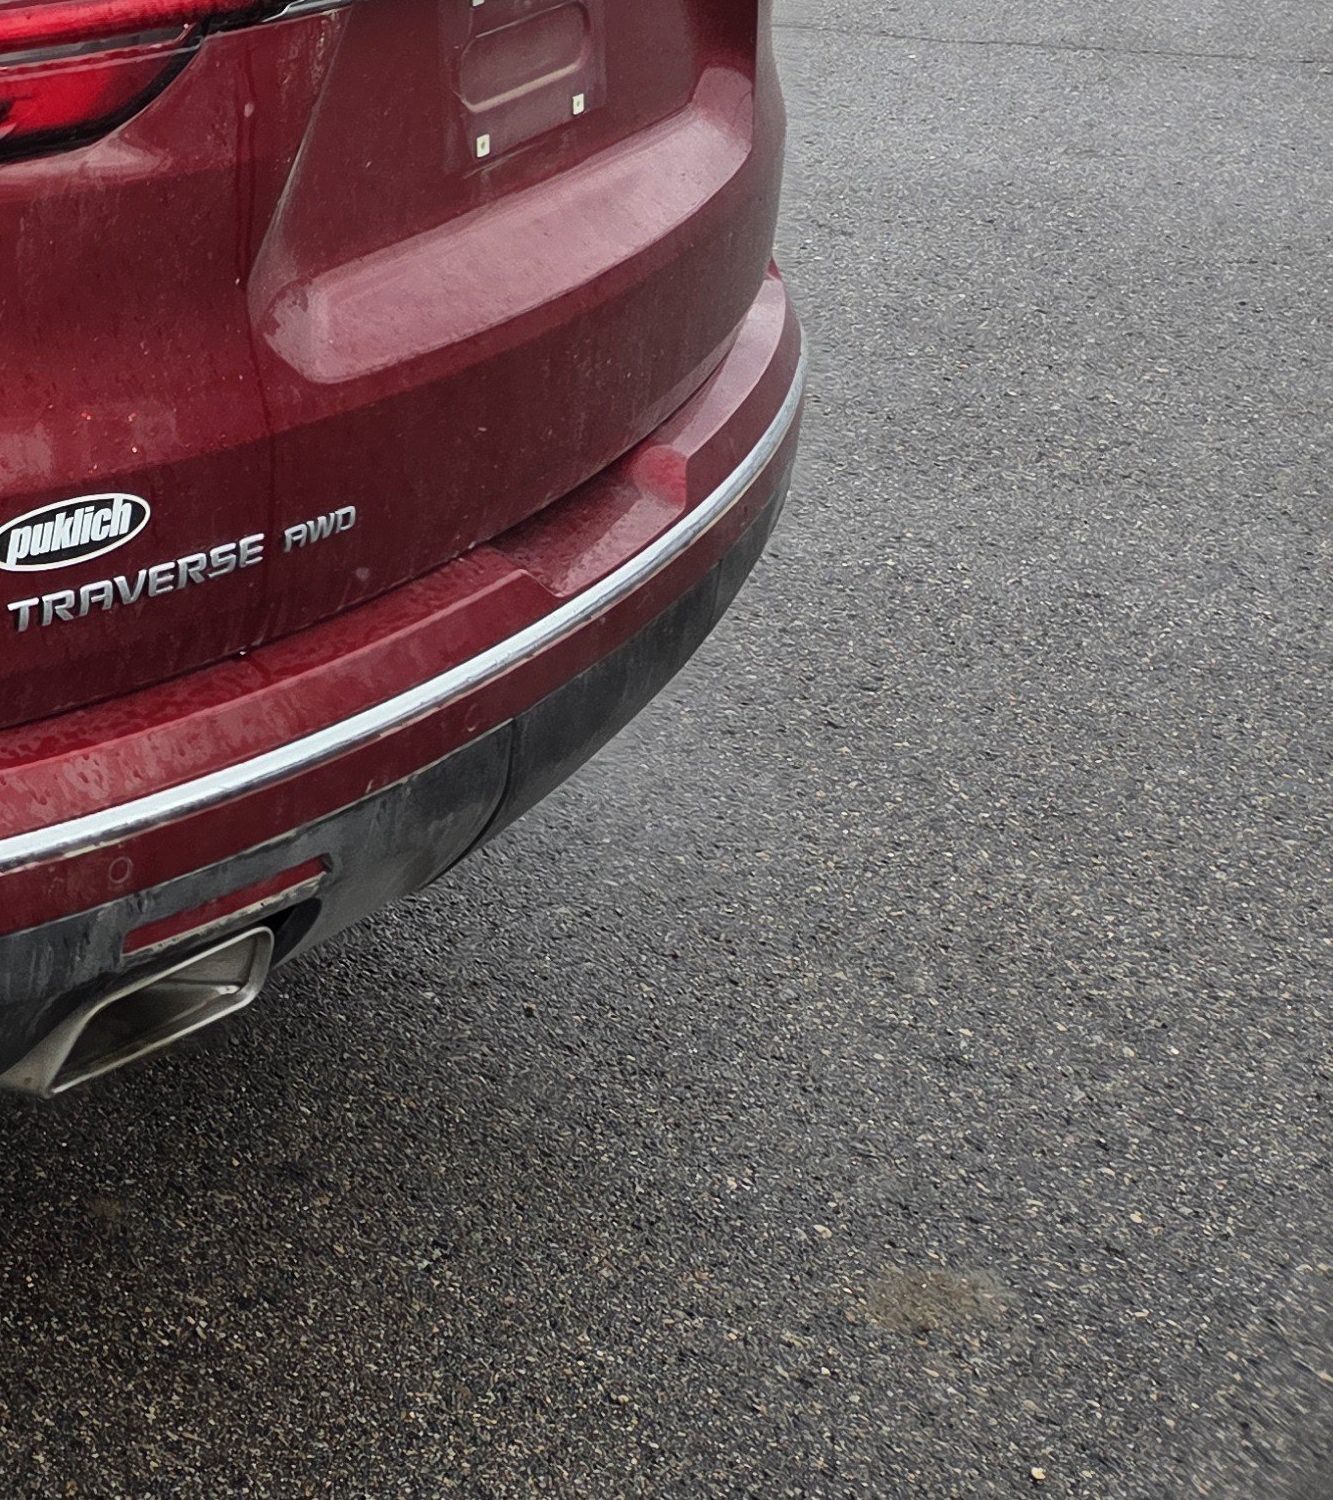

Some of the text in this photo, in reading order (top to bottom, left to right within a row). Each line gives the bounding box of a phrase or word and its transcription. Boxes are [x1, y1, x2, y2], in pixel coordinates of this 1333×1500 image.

[6, 497, 133, 566] puklich
[7, 505, 357, 633] TRAVERSE AWD
